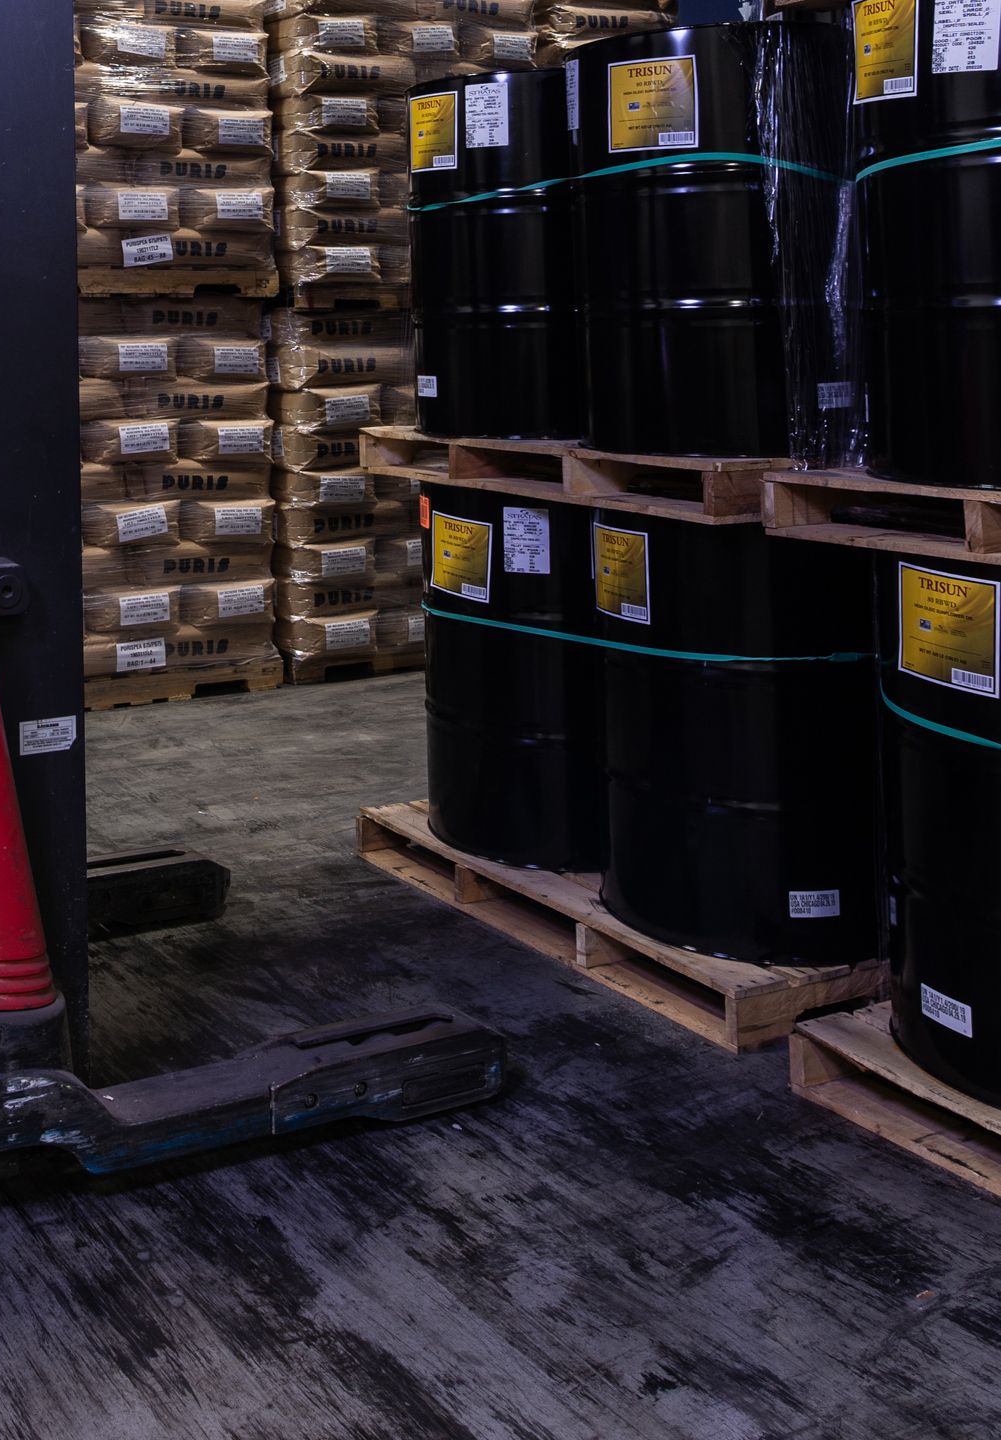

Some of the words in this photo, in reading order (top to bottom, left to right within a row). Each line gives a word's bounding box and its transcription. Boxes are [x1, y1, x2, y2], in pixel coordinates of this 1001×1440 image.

[155, 0, 220, 18] PURIS
[576, 16, 629, 28] PURIS
[627, 65, 672, 78] TRISUN
[417, 100, 441, 110] TRISUN
[317, 143, 377, 157] PURIS
[160, 161, 227, 179] PURIS
[318, 219, 377, 233] PURIS
[152, 310, 218, 325] PURIS
[311, 321, 372, 335] PURIS
[318, 358, 377, 373] PURIS
[157, 394, 225, 410] PURIS
[318, 442, 358, 458] PUR
[162, 475, 229, 490] PURIS
[314, 513, 374, 534] PURIS
[443, 521, 472, 535] TRISUN
[602, 533, 629, 546] TRISUN
[163, 558, 230, 574] PURIS
[918, 576, 967, 597] TRISUN
[314, 587, 374, 607] PURIS
